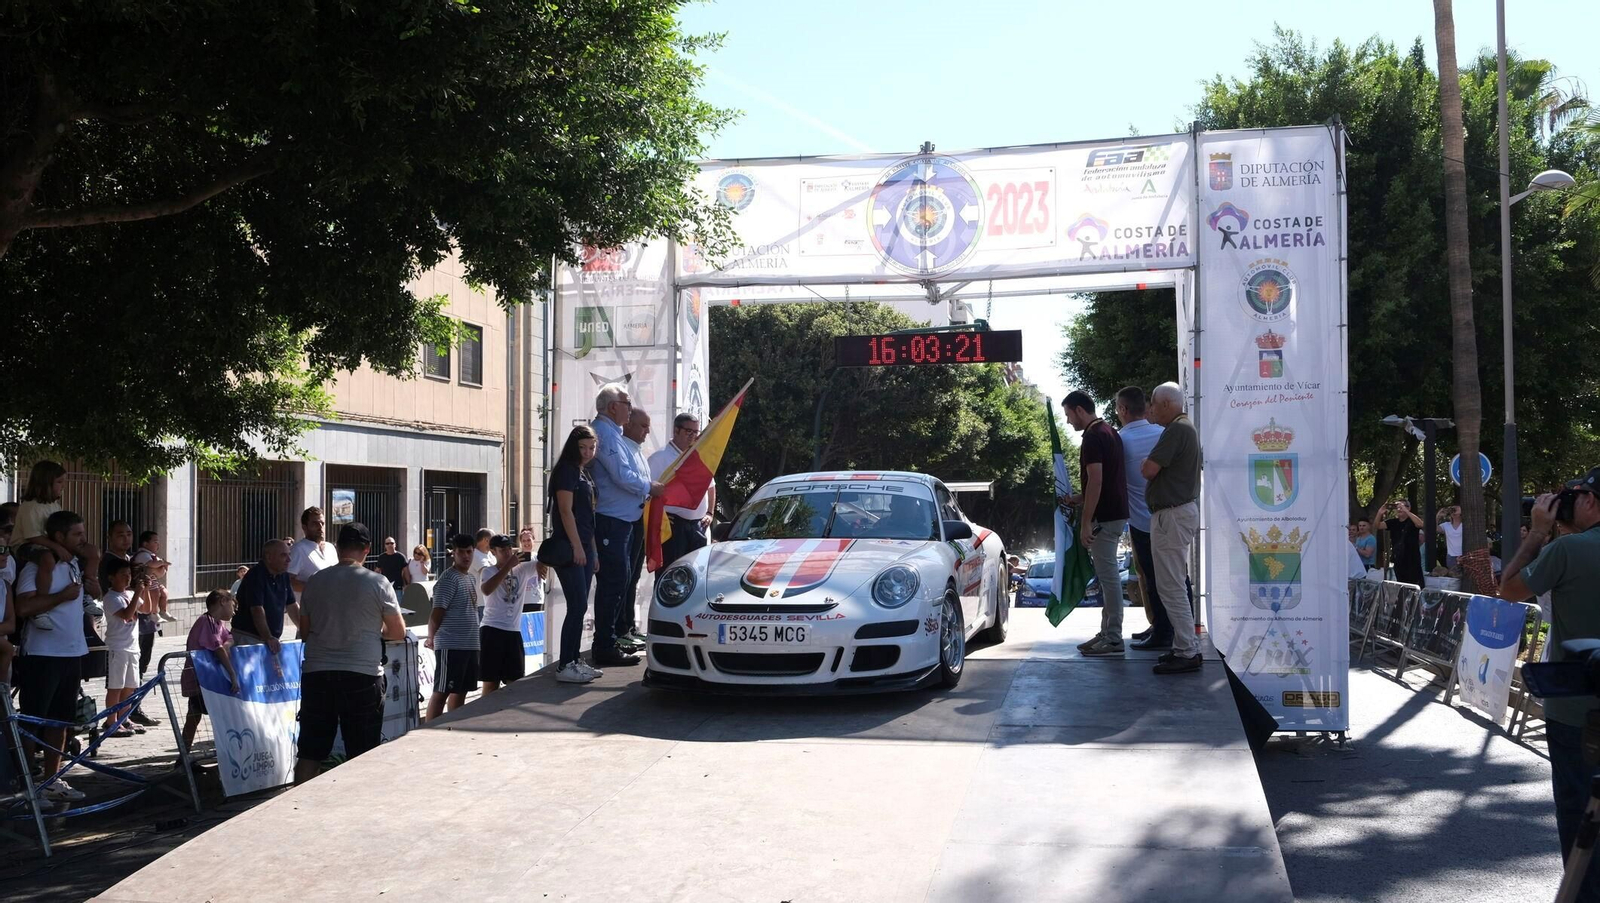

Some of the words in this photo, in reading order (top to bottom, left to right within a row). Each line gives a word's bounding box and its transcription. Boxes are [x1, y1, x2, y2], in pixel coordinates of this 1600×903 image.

[1240, 160, 1325, 174] DIPUTACIÓN
[1241, 177, 1258, 188] DE
[1262, 173, 1322, 187] ALMERÍA
[986, 181, 1050, 237] 2023
[1253, 217, 1301, 230] COSTA
[1304, 216, 1323, 228] DE
[1114, 225, 1165, 239] COSTA
[1168, 224, 1187, 237] DE
[1239, 228, 1326, 250] ALMERÍA
[732, 243, 790, 256] UTACIÓN
[1101, 236, 1190, 260] ALMERÍA
[1282, 267, 1298, 285] CLUB
[868, 333, 985, 365] 16:03:21
[1223, 382, 1282, 394] Ayuntamiento
[1284, 381, 1295, 391] de
[1297, 381, 1321, 390] Vícar
[1230, 397, 1263, 409] Corazón
[1264, 394, 1278, 404] del
[1279, 392, 1314, 403] Poniente
[776, 483, 904, 494] PORSCHE
[694, 612, 783, 621] AUTODESGUACES
[786, 612, 846, 621] SEVILLA
[729, 625, 769, 642] 5345
[774, 625, 806, 643] MCG
[253, 751, 274, 762] JUEGA
[253, 760, 275, 773] LIMPIO
